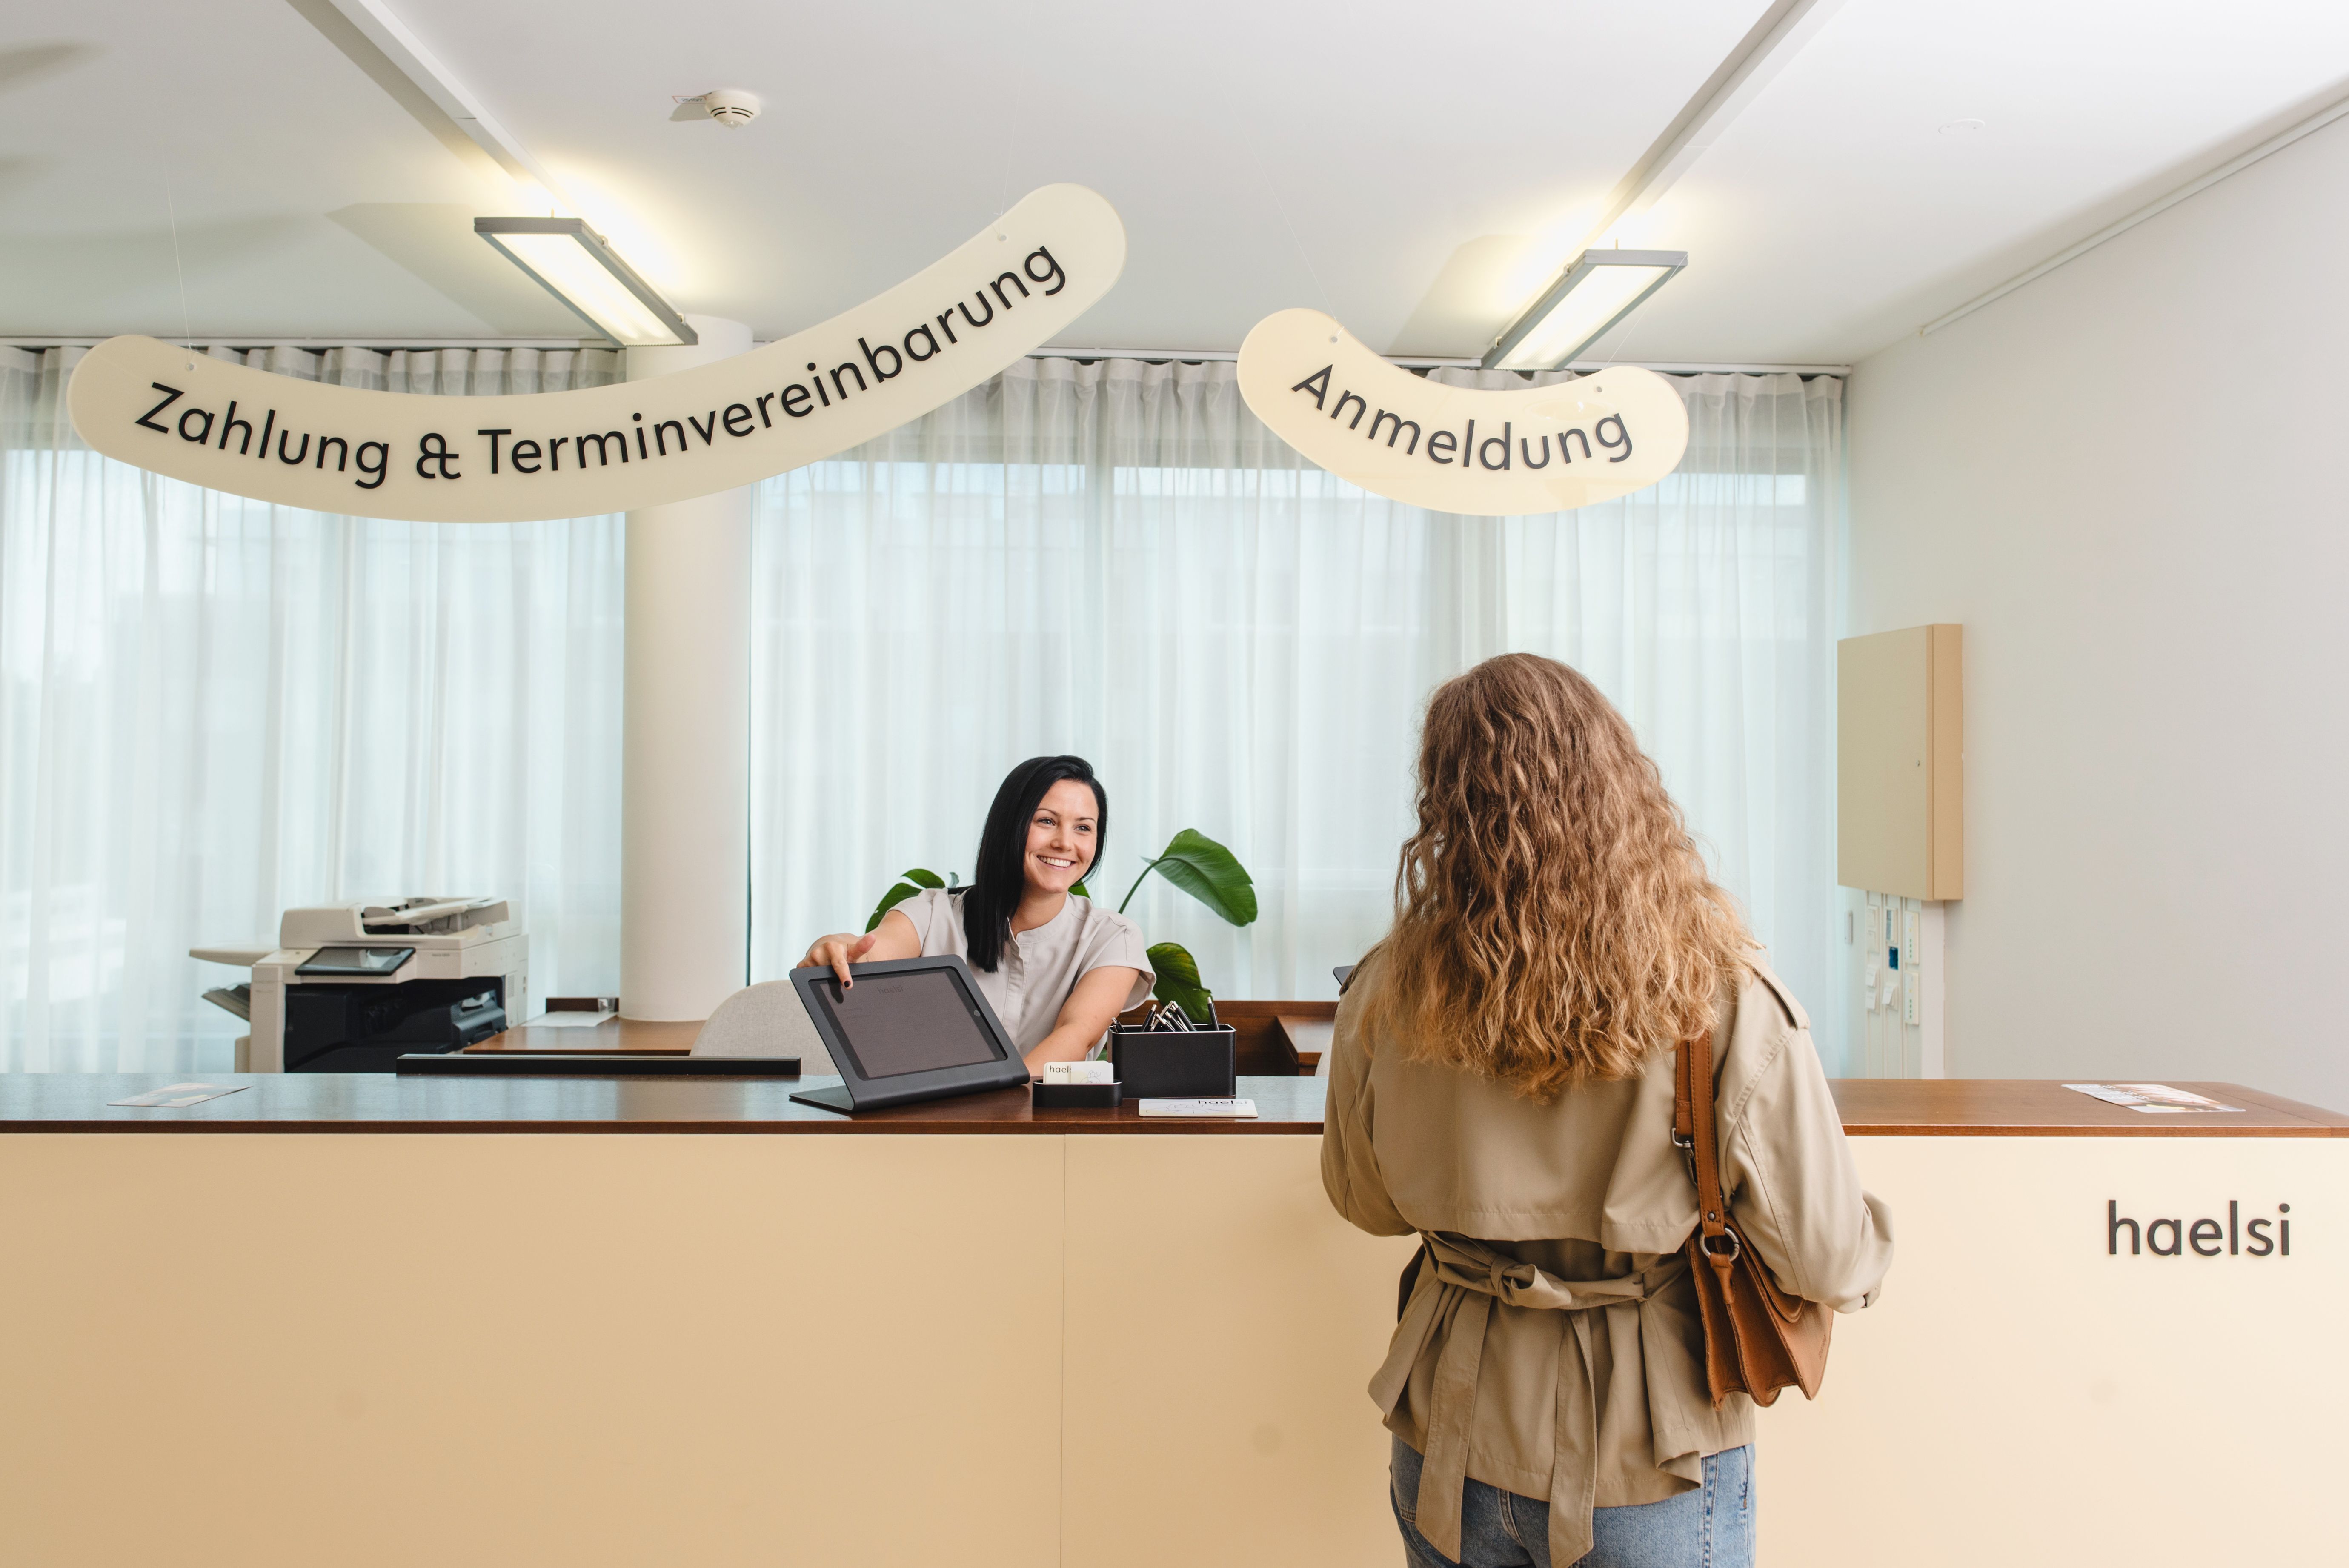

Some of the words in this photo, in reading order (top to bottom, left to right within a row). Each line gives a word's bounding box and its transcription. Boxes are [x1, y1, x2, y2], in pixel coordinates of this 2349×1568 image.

[135, 382, 389, 489] Zahlung
[416, 433, 461, 480] &
[478, 246, 1066, 474] Terminvereinbarung
[1291, 364, 1633, 470] Anmeldung
[877, 985, 904, 994] haelsi
[2108, 1199, 2290, 1256] haelsi
